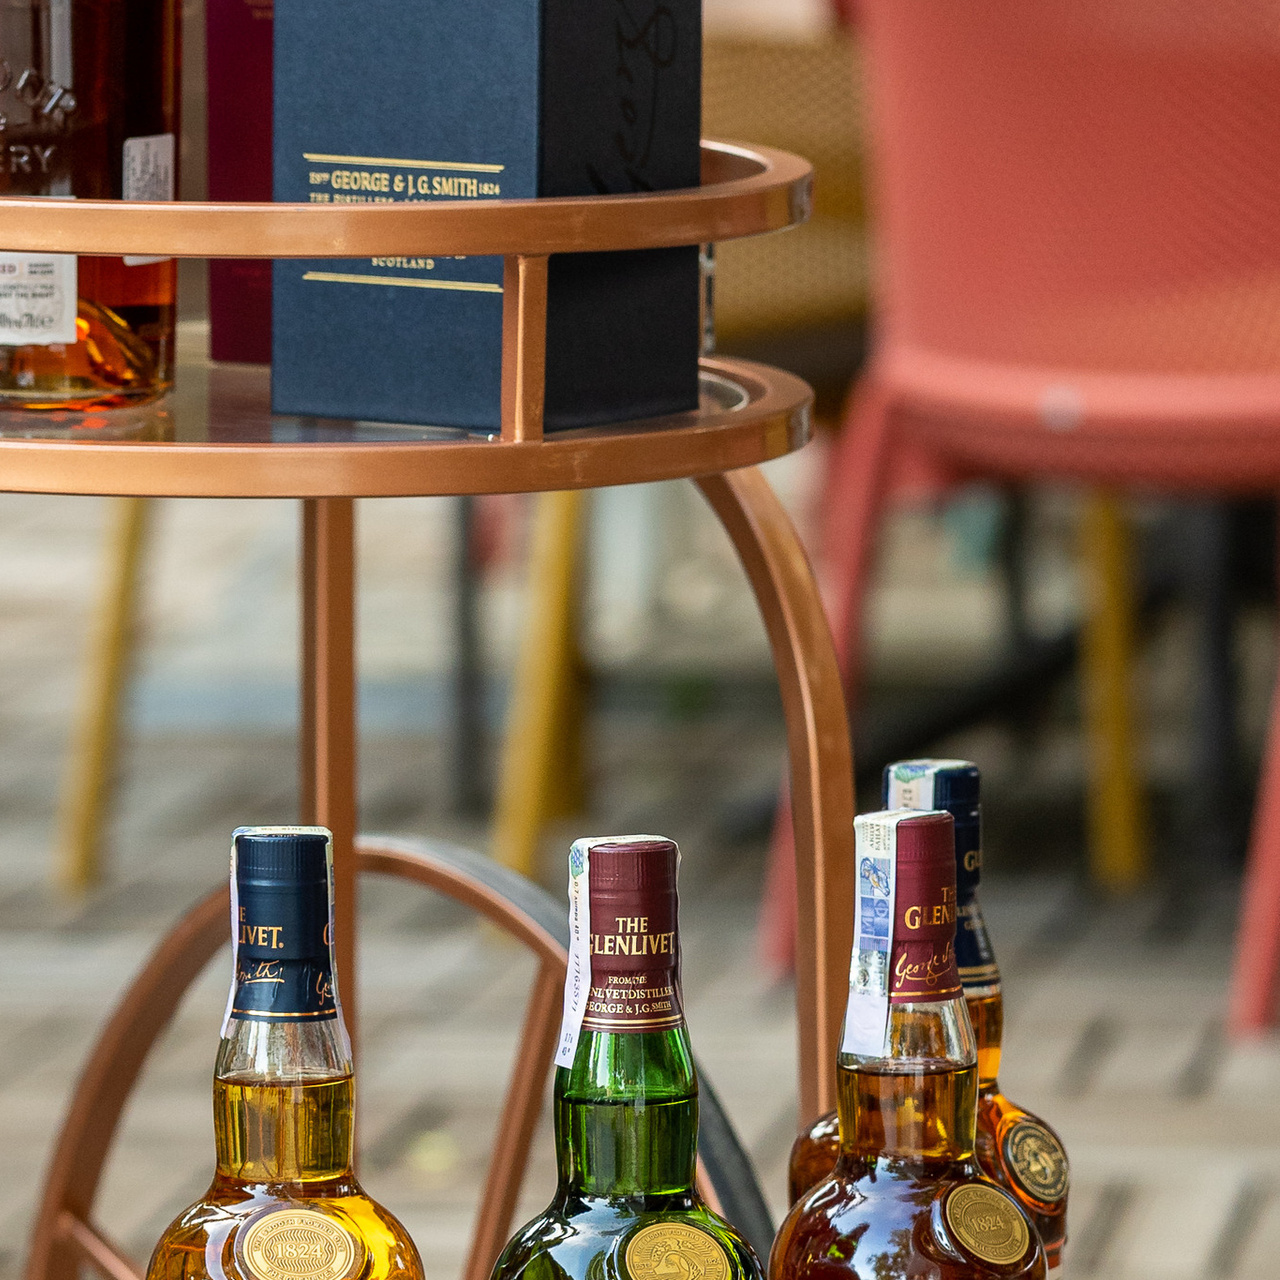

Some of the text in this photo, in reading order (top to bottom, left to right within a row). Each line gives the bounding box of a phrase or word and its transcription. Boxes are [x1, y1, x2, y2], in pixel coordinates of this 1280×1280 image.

[331, 170, 390, 192] GEORGE
[393, 175, 406, 192] &
[432, 177, 478, 197] SMITH
[615, 917, 648, 933] THE
[608, 976, 630, 984] FROM
[971, 1215, 1005, 1232] 1824
[276, 1243, 323, 1258] 1824
